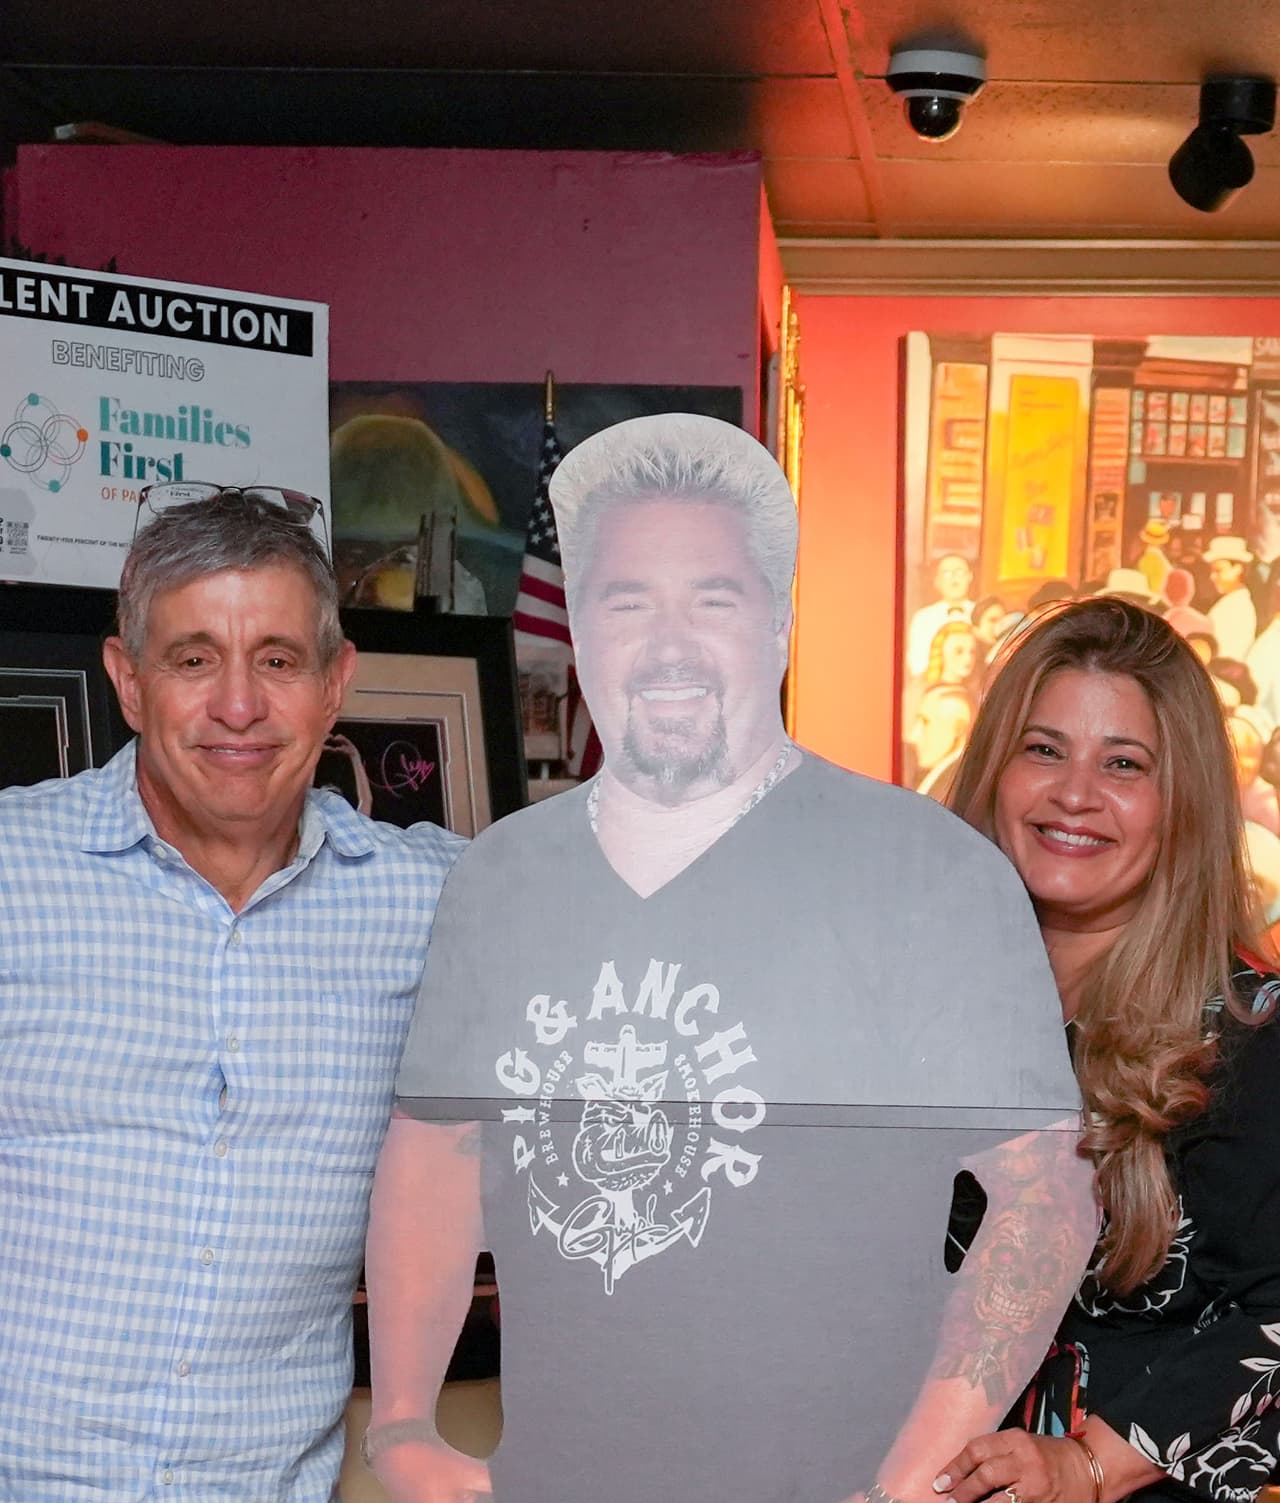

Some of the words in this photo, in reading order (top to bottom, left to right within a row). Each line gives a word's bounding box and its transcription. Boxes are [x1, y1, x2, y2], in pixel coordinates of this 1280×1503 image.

[108, 289, 290, 347] AUCTION
[52, 339, 206, 382] BENEFITING
[99, 395, 252, 449] Families
[99, 440, 184, 482] First
[101, 486, 117, 500] OF
[122, 488, 141, 503] PA
[495, 1047, 541, 1175] PIG
[526, 994, 578, 1045] &
[587, 958, 767, 1187] ANCHOR
[538, 1050, 573, 1166] BREWHOUSE
[674, 1053, 702, 1178] SMOKEHOUSE
